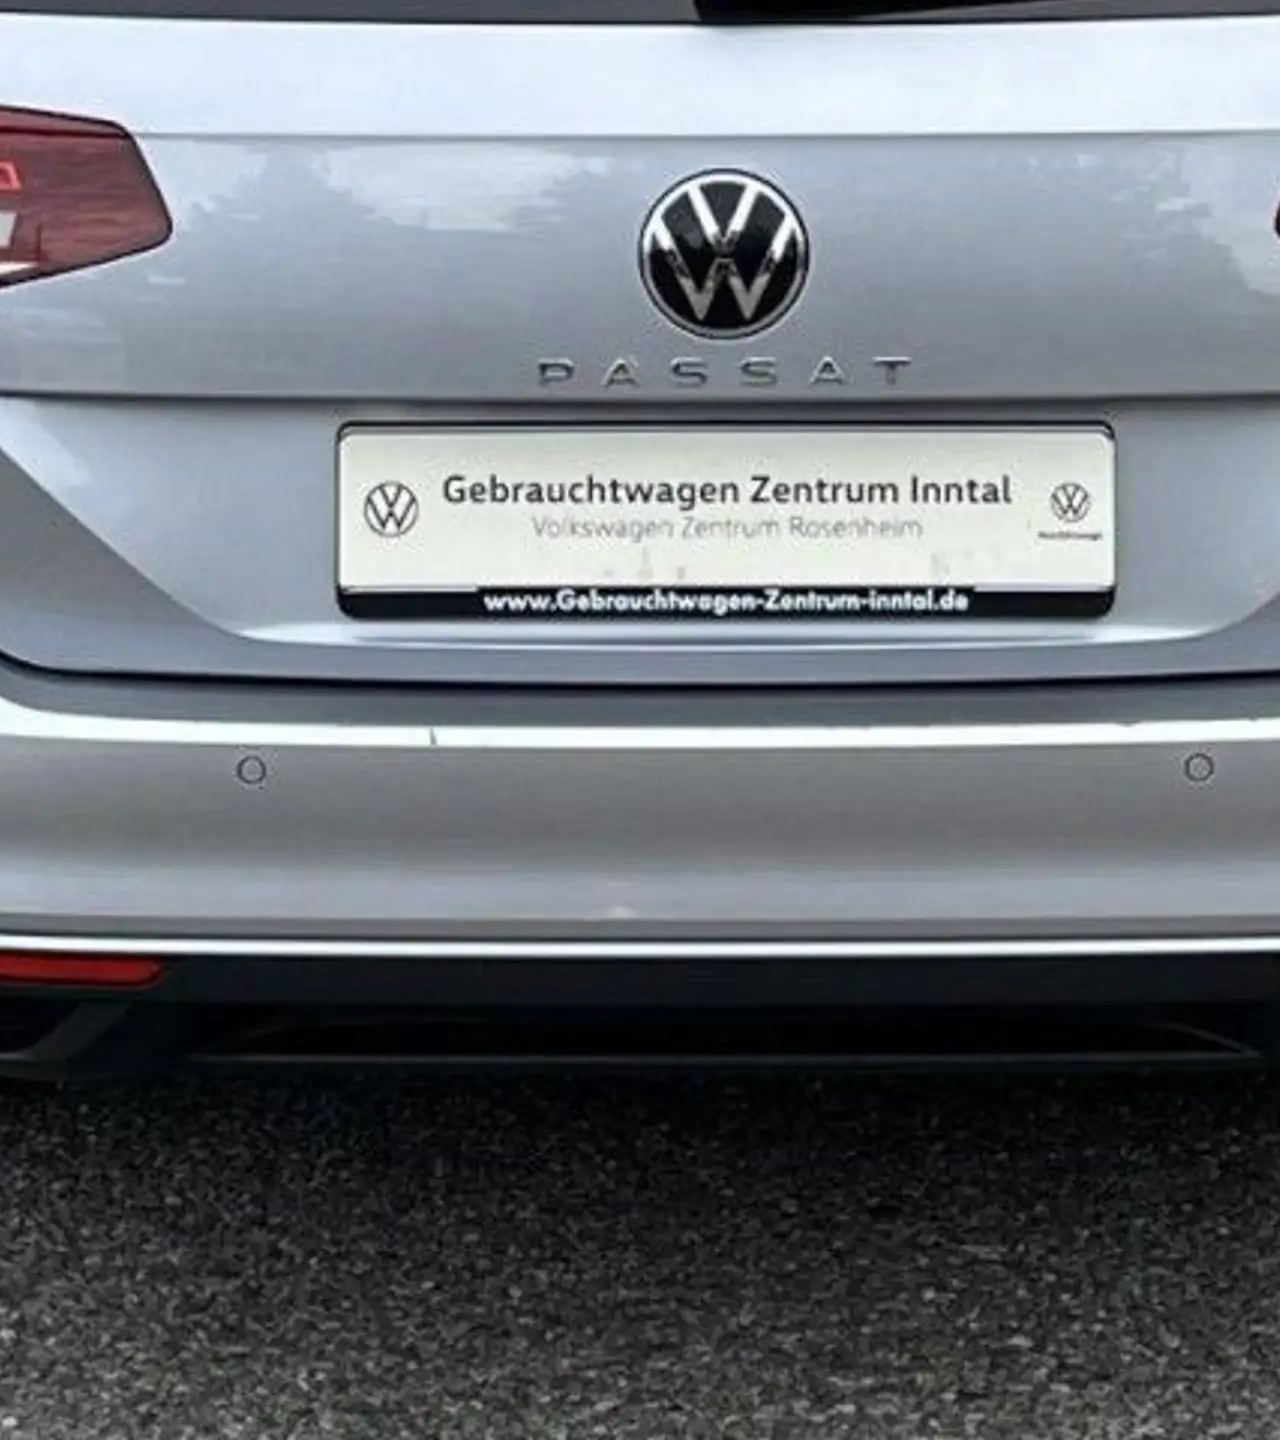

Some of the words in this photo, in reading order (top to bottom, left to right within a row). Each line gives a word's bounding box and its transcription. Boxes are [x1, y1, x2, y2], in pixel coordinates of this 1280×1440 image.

[637, 167, 810, 340] VW
[537, 360, 912, 389] PASSAT
[442, 473, 740, 510] Gebrauchtwagen
[750, 474, 900, 505] Zentrum
[910, 474, 1012, 505] Inntal
[531, 516, 674, 545] Volkswagen
[681, 516, 781, 540] Zentrum
[788, 516, 924, 540] Rosenheim
[483, 588, 970, 617] www.Gebrauchtwagen-Zentrum-inntal.de
